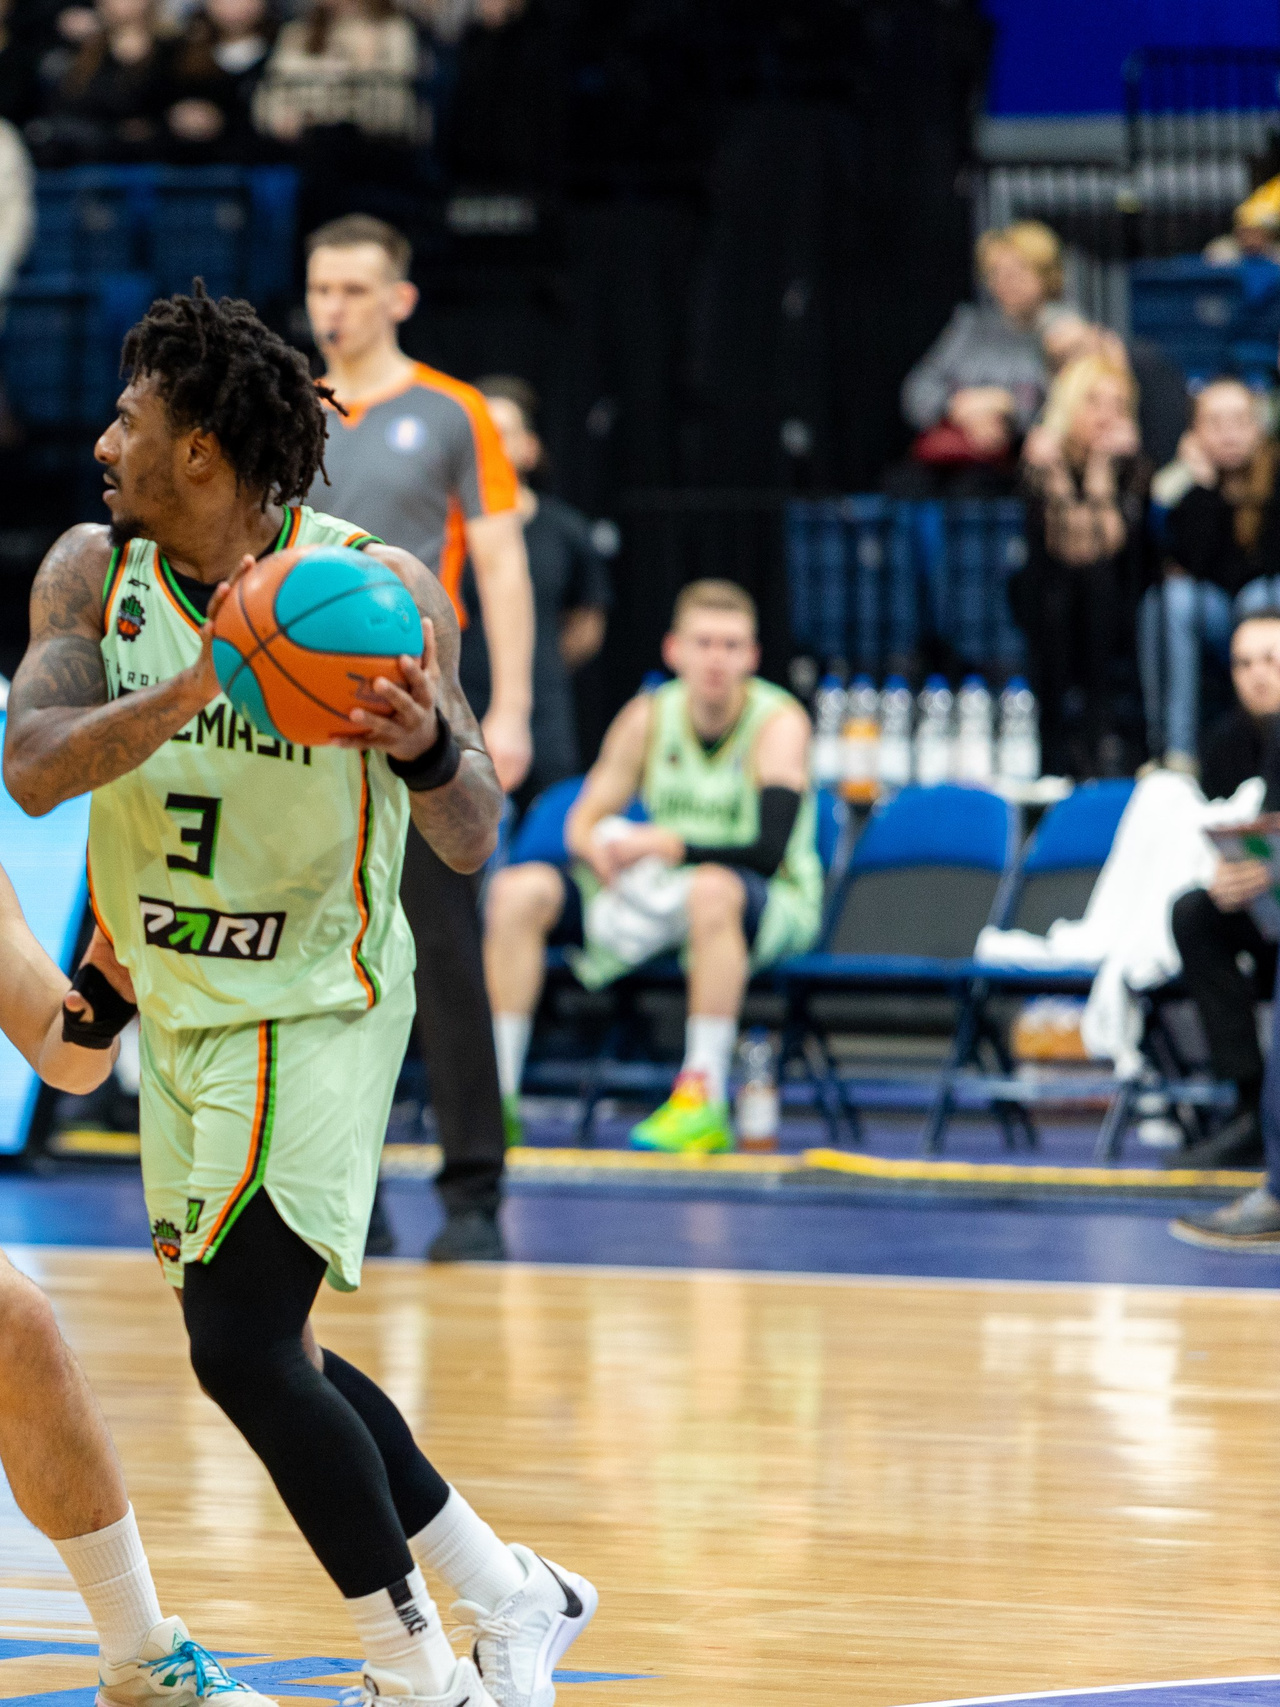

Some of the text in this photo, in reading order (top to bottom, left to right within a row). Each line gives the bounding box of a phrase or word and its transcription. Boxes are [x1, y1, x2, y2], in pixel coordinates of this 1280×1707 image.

[165, 793, 222, 879] 3
[139, 900, 280, 957] PARI
[396, 1603, 428, 1637] NIKE
